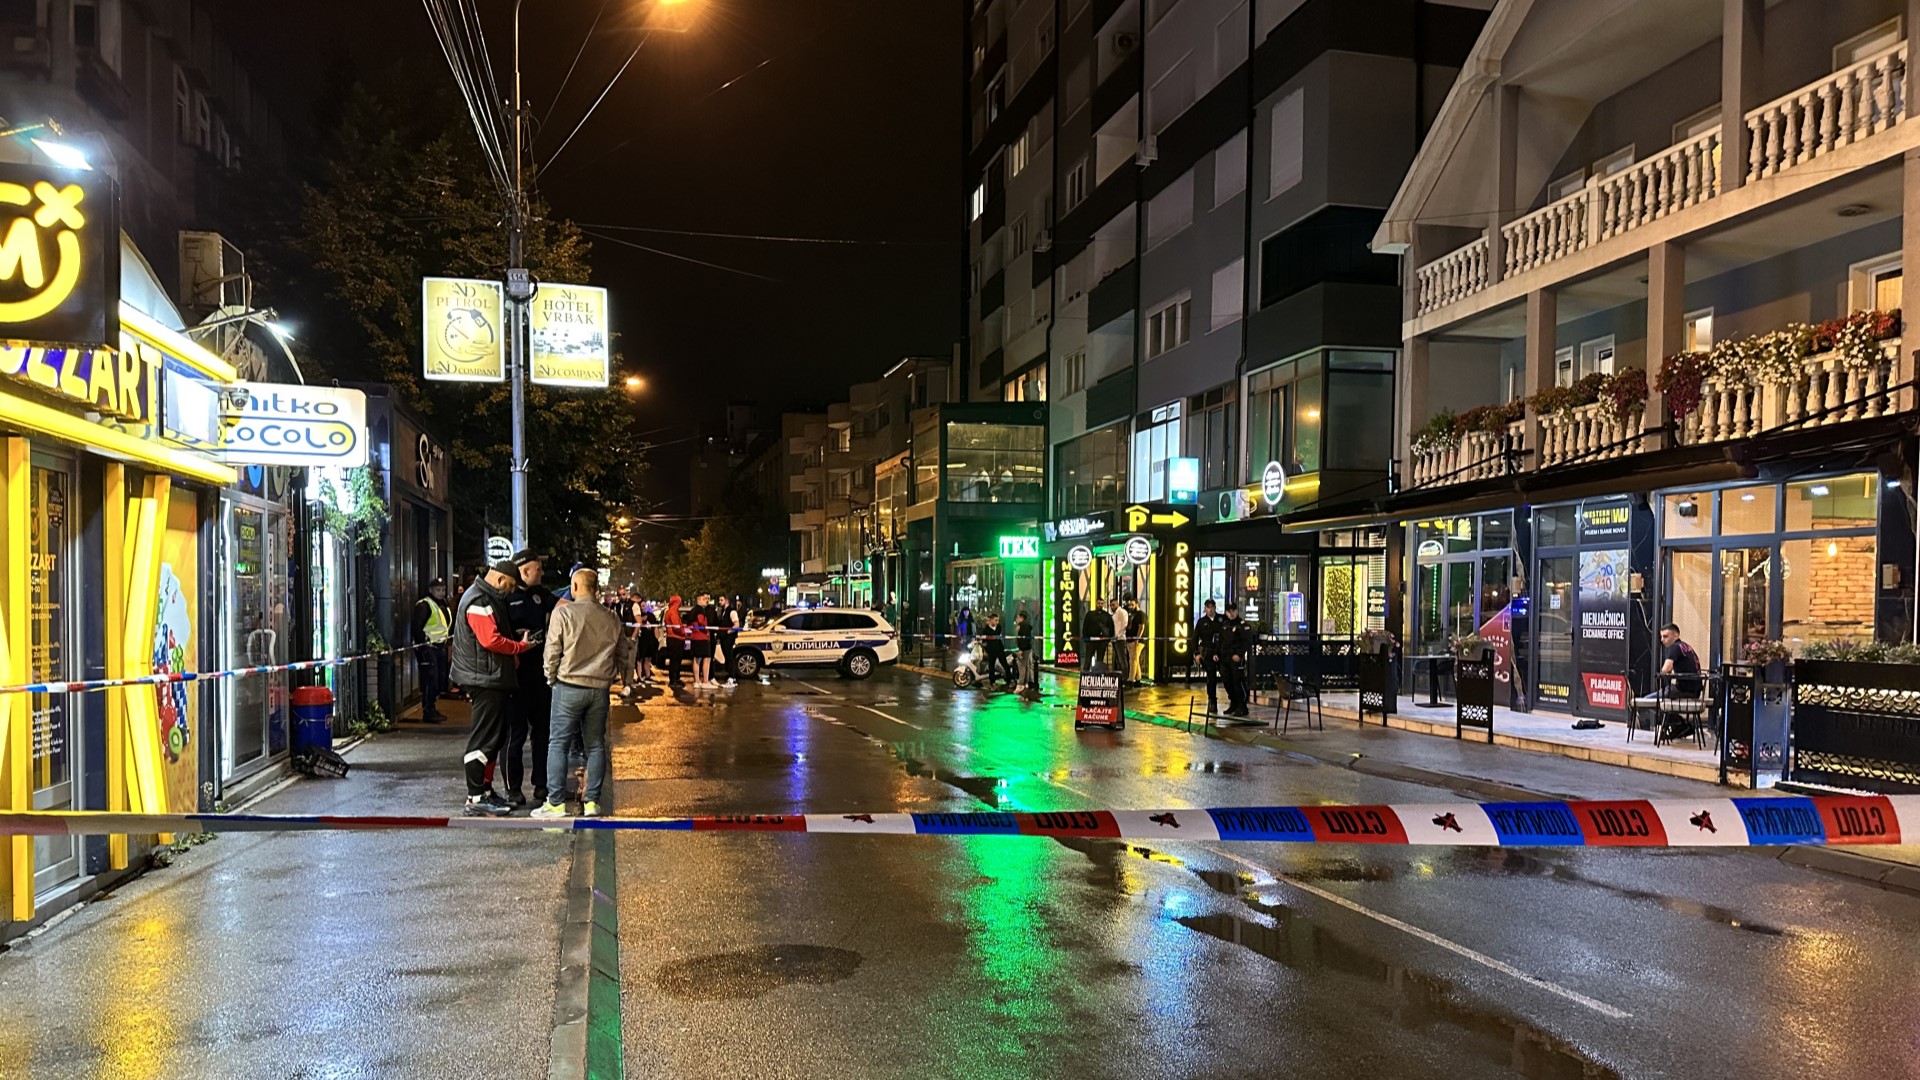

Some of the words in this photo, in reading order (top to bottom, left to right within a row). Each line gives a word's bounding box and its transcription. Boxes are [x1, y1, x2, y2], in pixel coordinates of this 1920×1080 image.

[436, 297, 491, 309] PETROL
[544, 300, 594, 313] HOTEL
[543, 311, 594, 325] VRBAK
[458, 366, 498, 376] COMPANY
[557, 368, 604, 380] COMPANY
[1129, 511, 1147, 532] P
[1592, 517, 1610, 525] UNION
[1174, 542, 1189, 653] PARKING
[1060, 561, 1074, 651] MENJAČNICA
[1582, 609, 1625, 627] MENJAČNICA
[1583, 629, 1608, 640] EXCHANGE
[1608, 630, 1625, 640] OFFICE
[787, 641, 840, 650] ПОЛИЦИЈА
[1081, 674, 1119, 688] MENJAČNICA
[1592, 691, 1619, 705] RAČUNA
